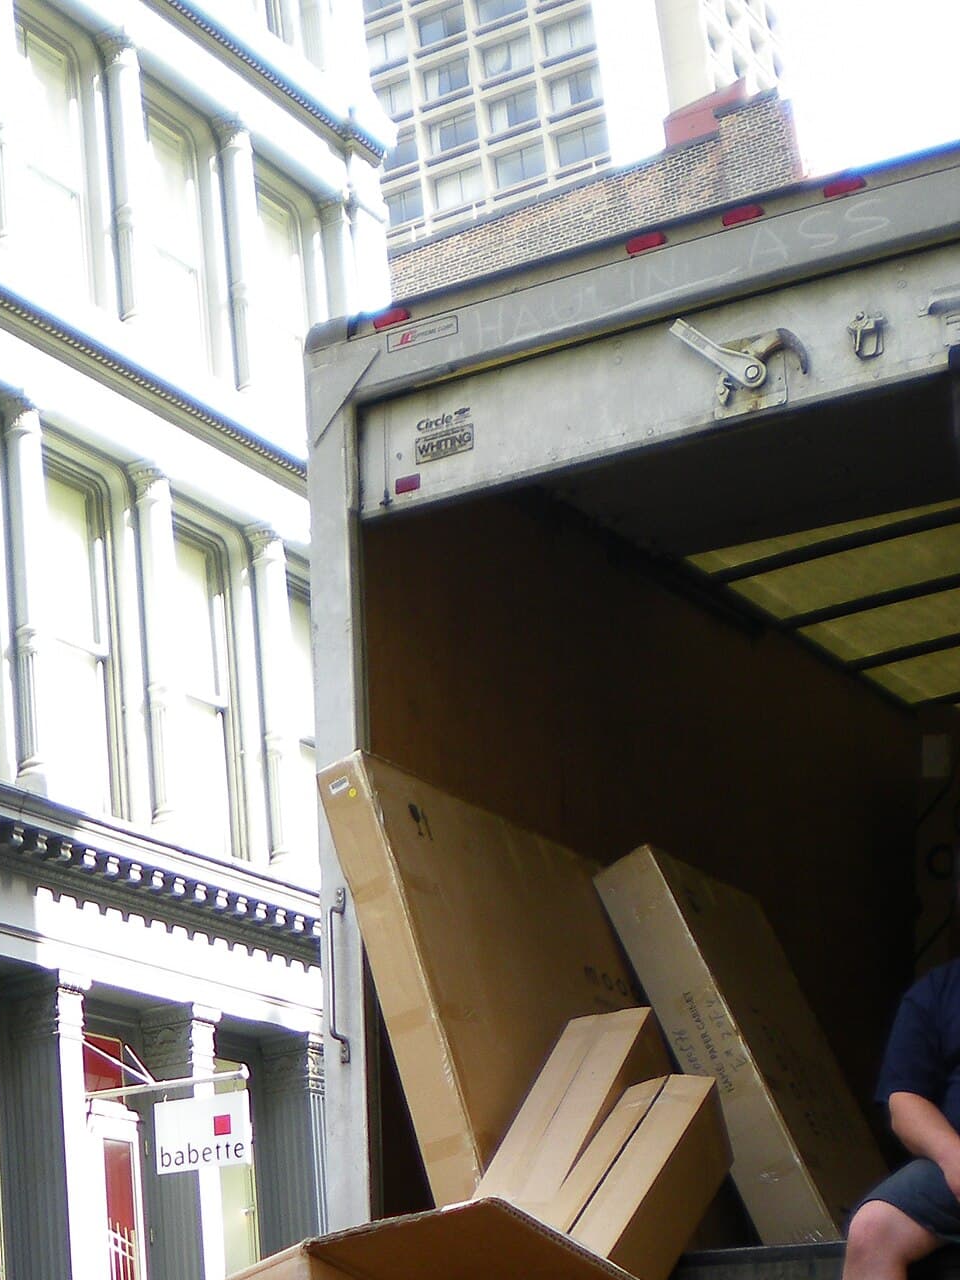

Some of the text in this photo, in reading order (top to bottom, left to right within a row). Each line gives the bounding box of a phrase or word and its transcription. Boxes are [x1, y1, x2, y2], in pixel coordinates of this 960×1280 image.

[748, 198, 891, 269] ASS
[417, 413, 452, 432] Circle
[160, 1141, 245, 1168] babette
